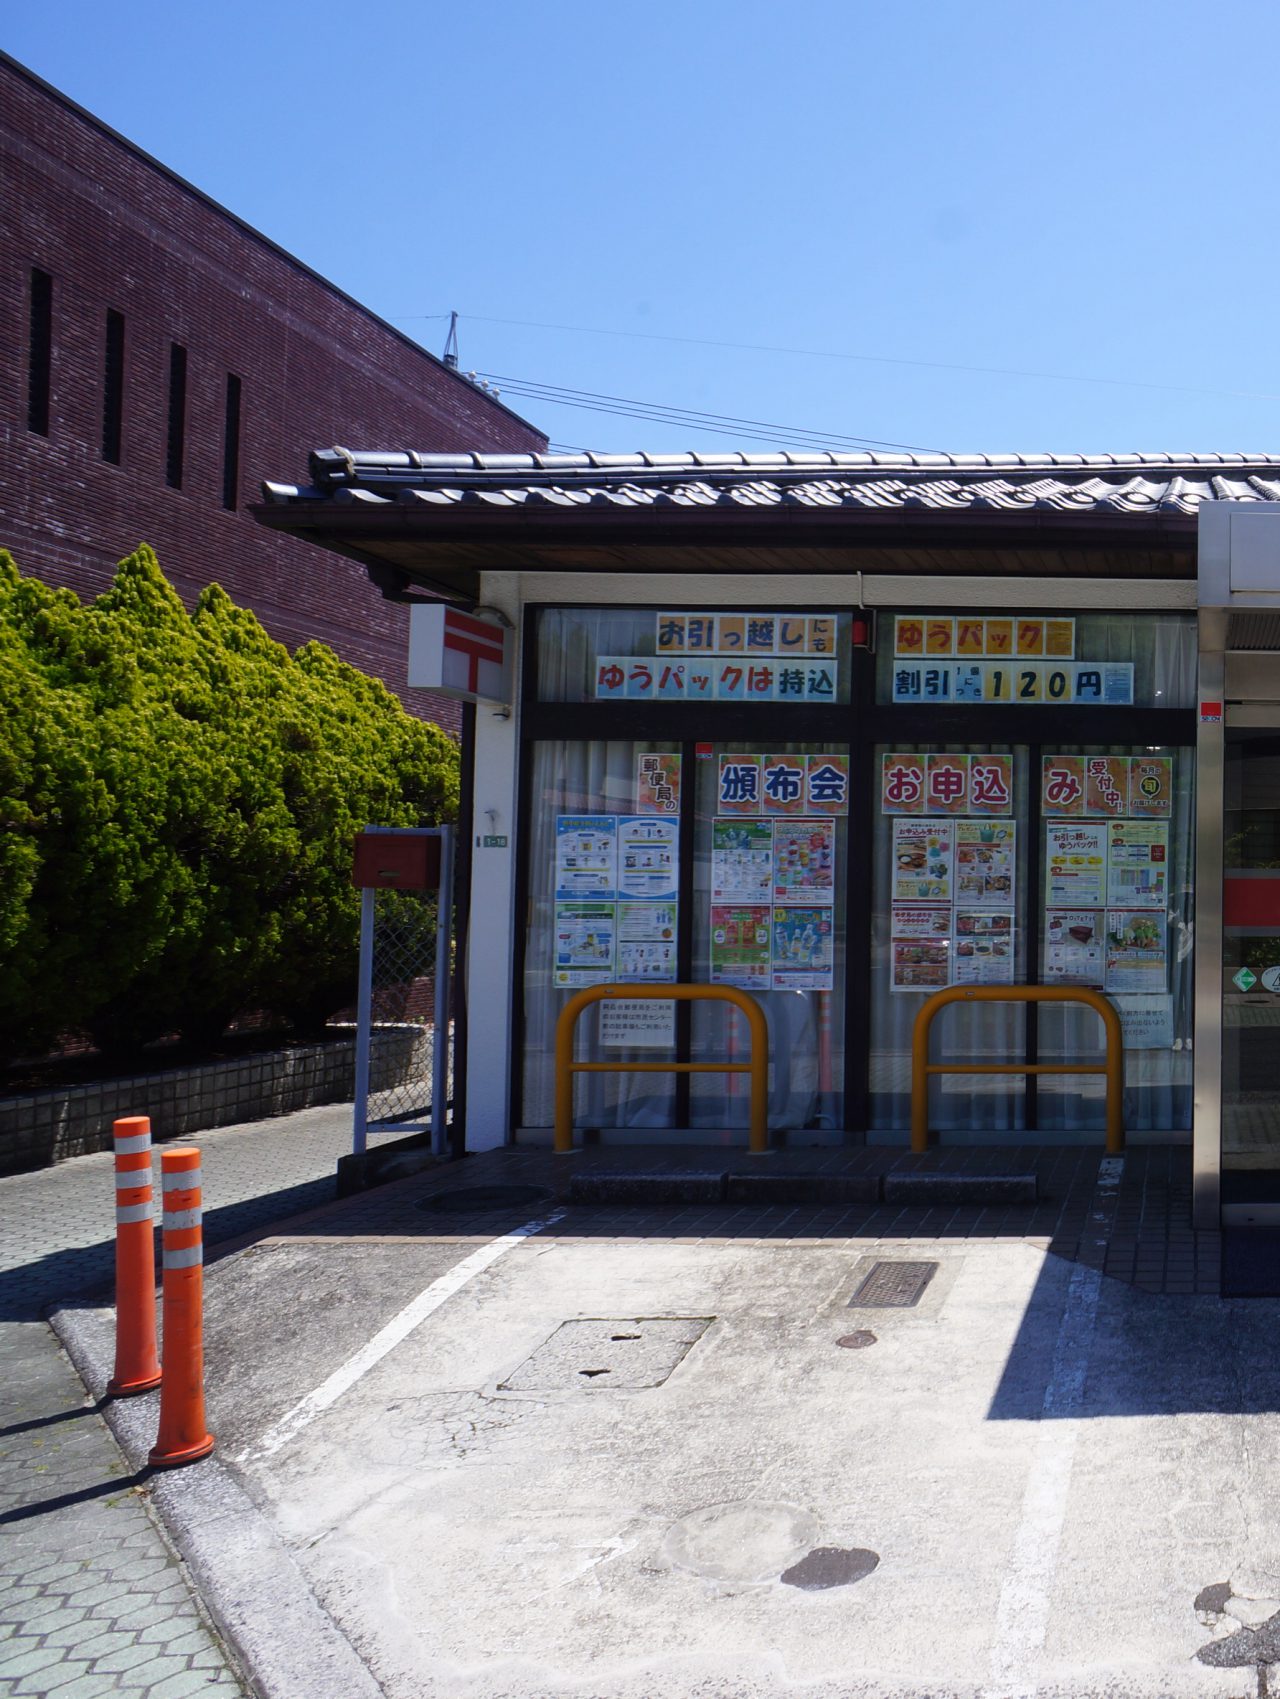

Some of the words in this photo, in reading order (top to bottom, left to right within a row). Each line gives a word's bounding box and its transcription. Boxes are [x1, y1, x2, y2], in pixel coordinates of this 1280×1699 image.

[899, 623, 1042, 648] ゆうパック
[599, 664, 833, 695] ゆうパックは持込
[642, 757, 676, 811] 郵便局の
[721, 766, 846, 803] 頒布会
[1143, 780, 1157, 793] 旬
